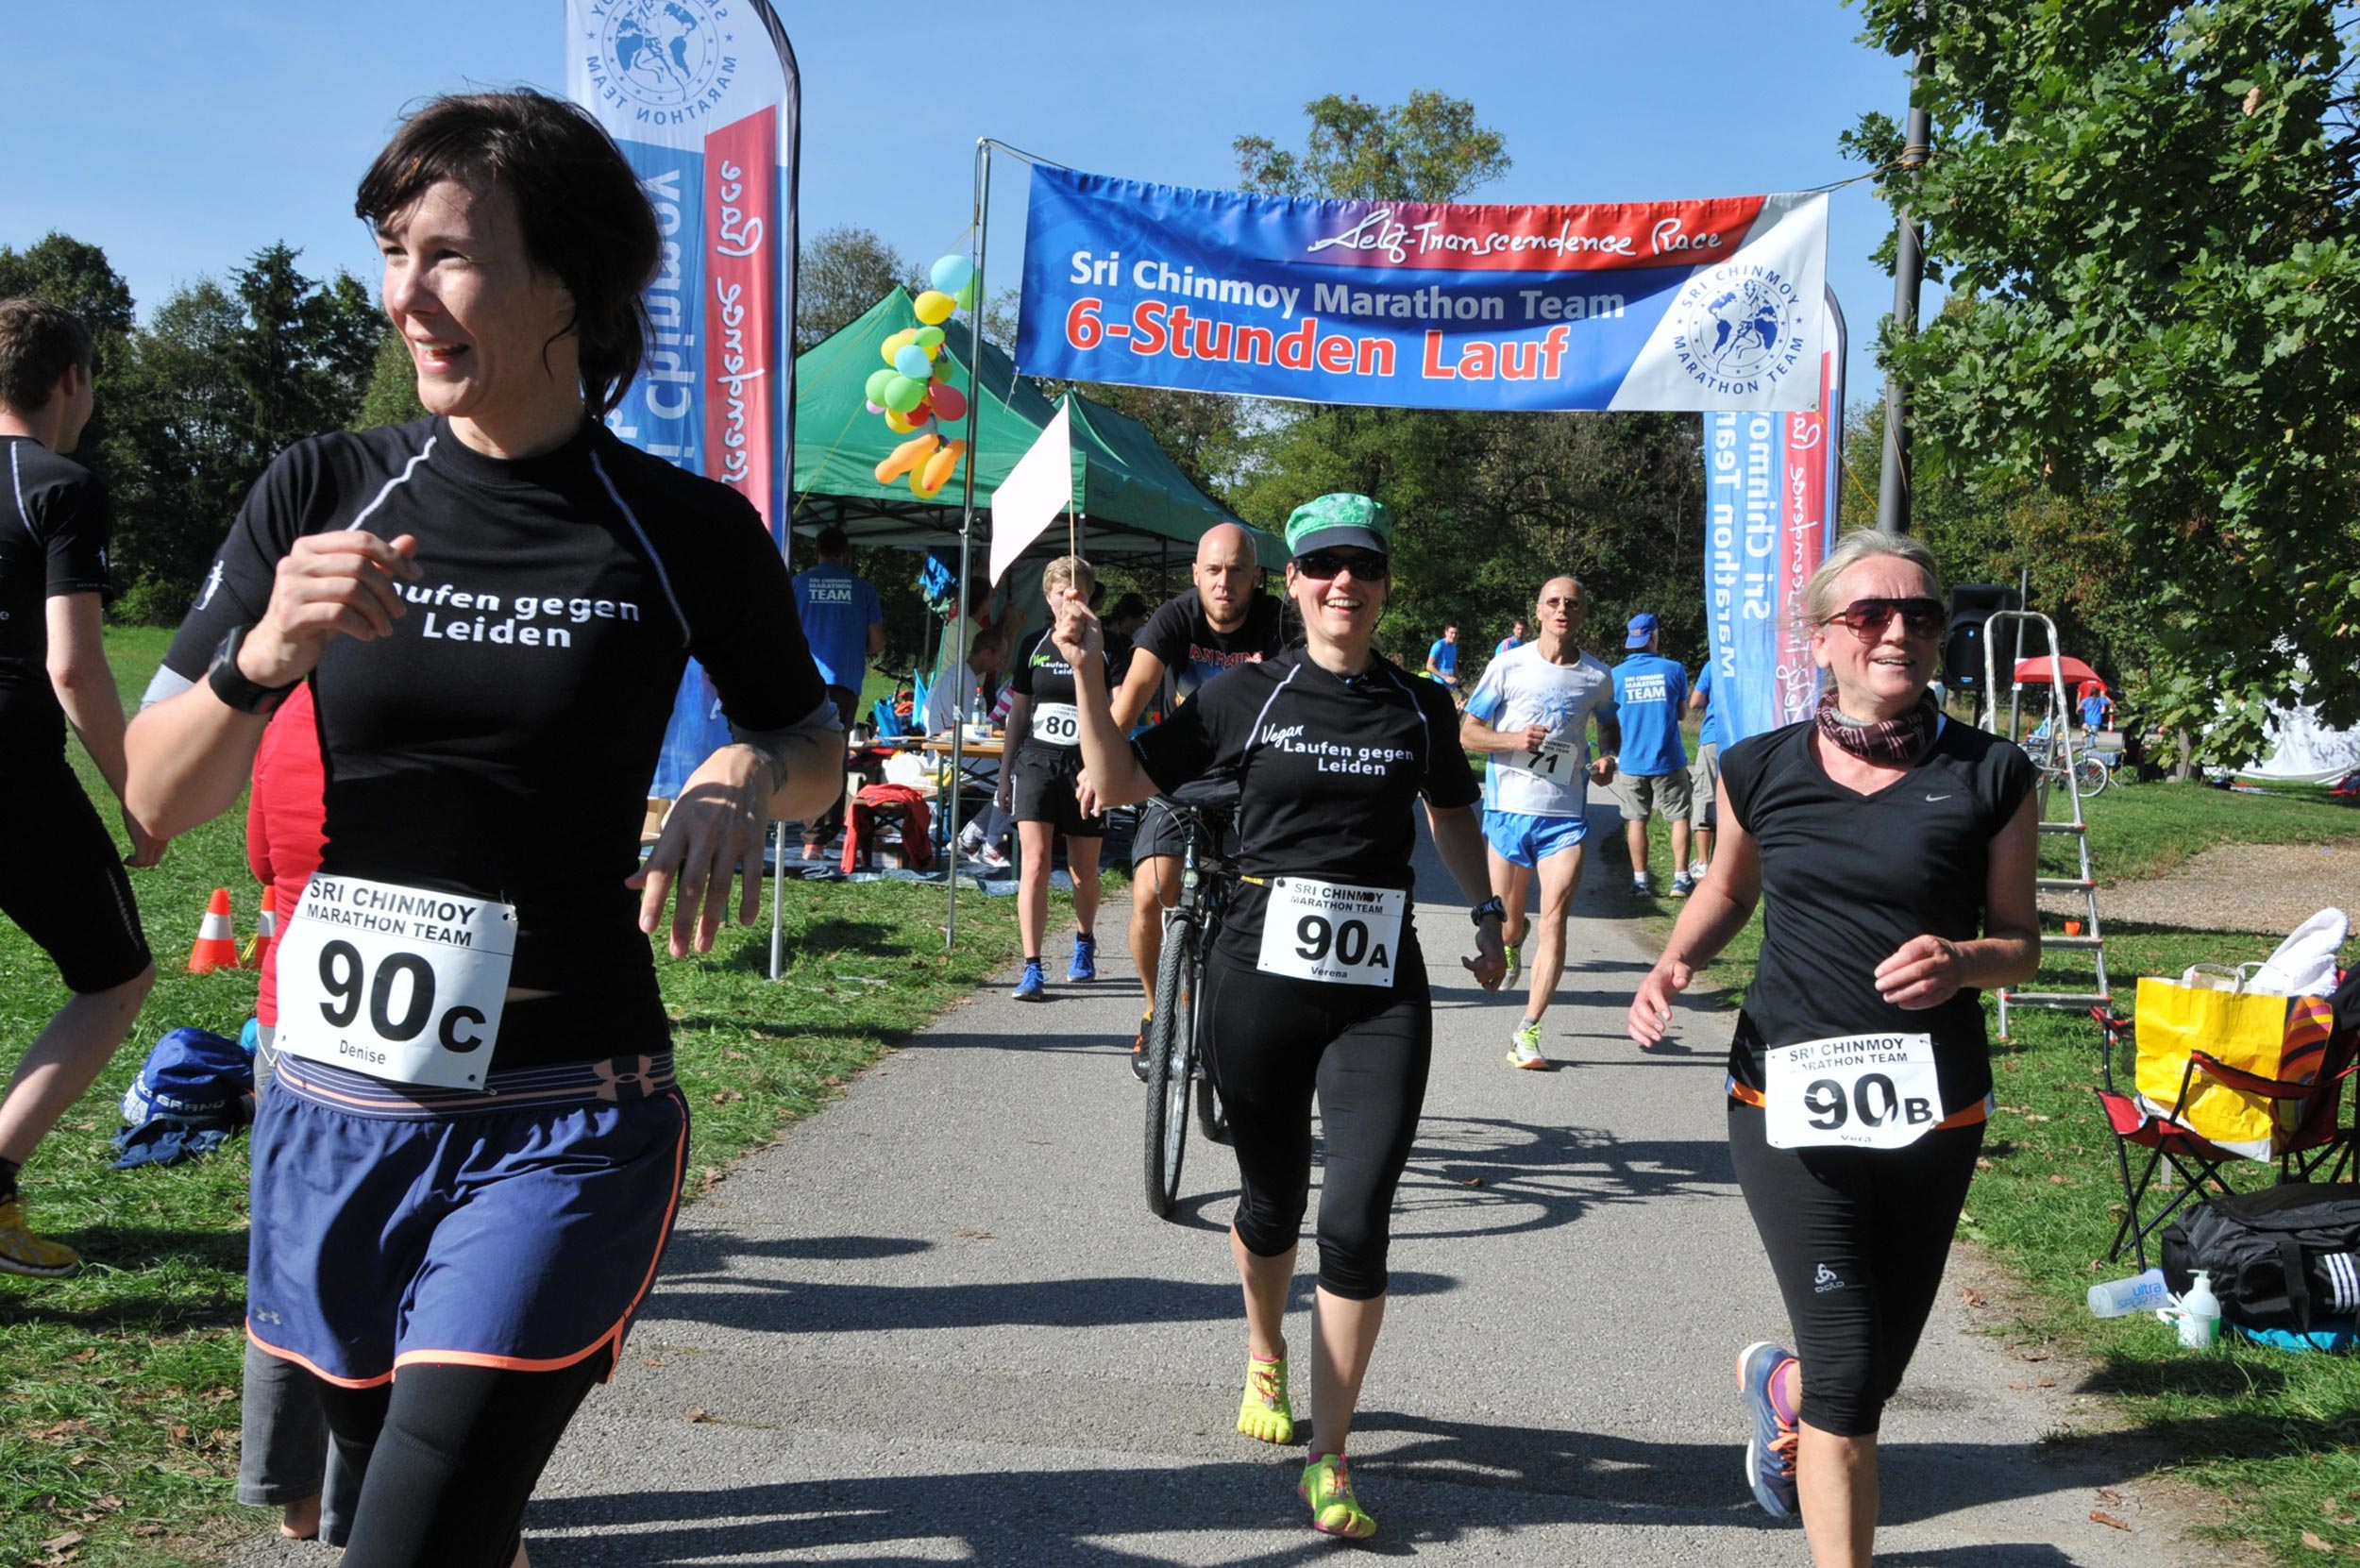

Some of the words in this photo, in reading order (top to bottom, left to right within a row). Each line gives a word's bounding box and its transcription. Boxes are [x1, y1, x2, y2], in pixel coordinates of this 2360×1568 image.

[1307, 208, 1638, 264] Self-Transcendence
[1651, 217, 1723, 255] Race
[1070, 250, 1120, 287] Sri
[1133, 260, 1301, 320] Chinmoy
[1314, 282, 1506, 320] Marathon
[1519, 289, 1625, 320] Team
[1681, 281, 1708, 309] SRI
[1715, 264, 1800, 305] CHINMOY
[1065, 296, 1397, 378] 6-Stunden
[1422, 325, 1571, 380] Lauf
[1674, 334, 1760, 395] MARATHON
[1766, 337, 1804, 383] TEAM
[392, 582, 500, 612] ufen
[514, 596, 641, 623] gegen
[808, 589, 851, 601] TEAM
[422, 612, 571, 649] Leiden
[1626, 685, 1666, 700] TEAM
[1046, 716, 1077, 738] 80
[1261, 723, 1304, 749] Vegan
[1283, 739, 1352, 757] Laufen
[1358, 746, 1414, 763] gegen
[1527, 750, 1559, 773] 71
[1317, 757, 1387, 776] Leiden
[310, 879, 346, 903] SRI
[352, 887, 477, 926] CHINMOY
[1293, 883, 1318, 896] SRI
[1290, 896, 1353, 911] MARATHON
[1356, 903, 1384, 914] TEAM
[307, 902, 407, 936] MARATHON
[413, 922, 474, 947] TEAM
[1310, 966, 1348, 979] Verena
[339, 1039, 387, 1065] Denise
[1790, 1047, 1814, 1063] SRI
[1821, 1037, 1905, 1056] CHINMOY
[1790, 1055, 1865, 1074] ARATHON
[1869, 1053, 1908, 1063] TEAM
[2132, 1282, 2162, 1297] ultra
